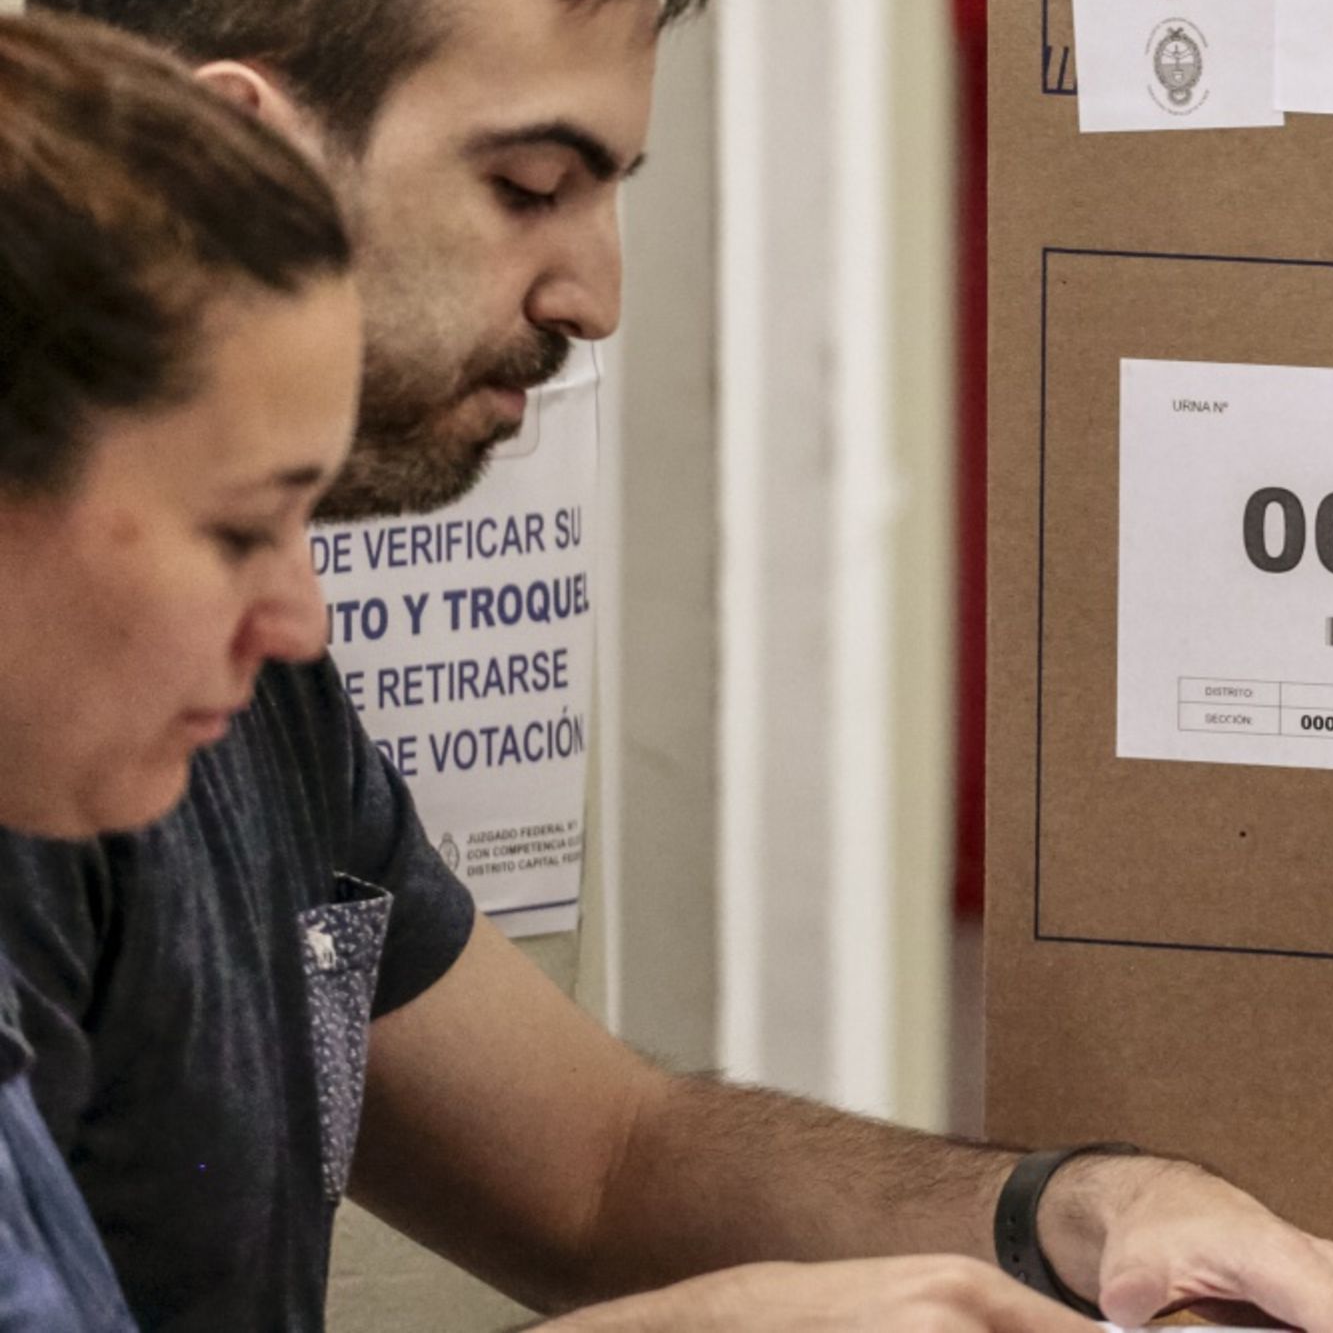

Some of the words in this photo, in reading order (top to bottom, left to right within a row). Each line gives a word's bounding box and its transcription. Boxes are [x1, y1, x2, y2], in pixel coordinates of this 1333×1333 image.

[1172, 399, 1211, 413] URNA
[310, 532, 352, 576] DE
[363, 512, 546, 570] VERIFICAR
[555, 505, 582, 550] SU
[326, 597, 389, 646] TO
[403, 592, 430, 636] Y
[443, 572, 590, 632] TROQUEL
[345, 670, 365, 712] E
[378, 648, 569, 710] RETIRARSE
[429, 704, 585, 774] VOTACIÓN
[467, 828, 518, 844] JUZGADO
[520, 822, 566, 838] FEDERAL
[467, 847, 490, 861] CON
[492, 838, 566, 857] COMPETENCIA
[467, 860, 516, 877] DISTRITO
[518, 855, 560, 871] CAPITAL
